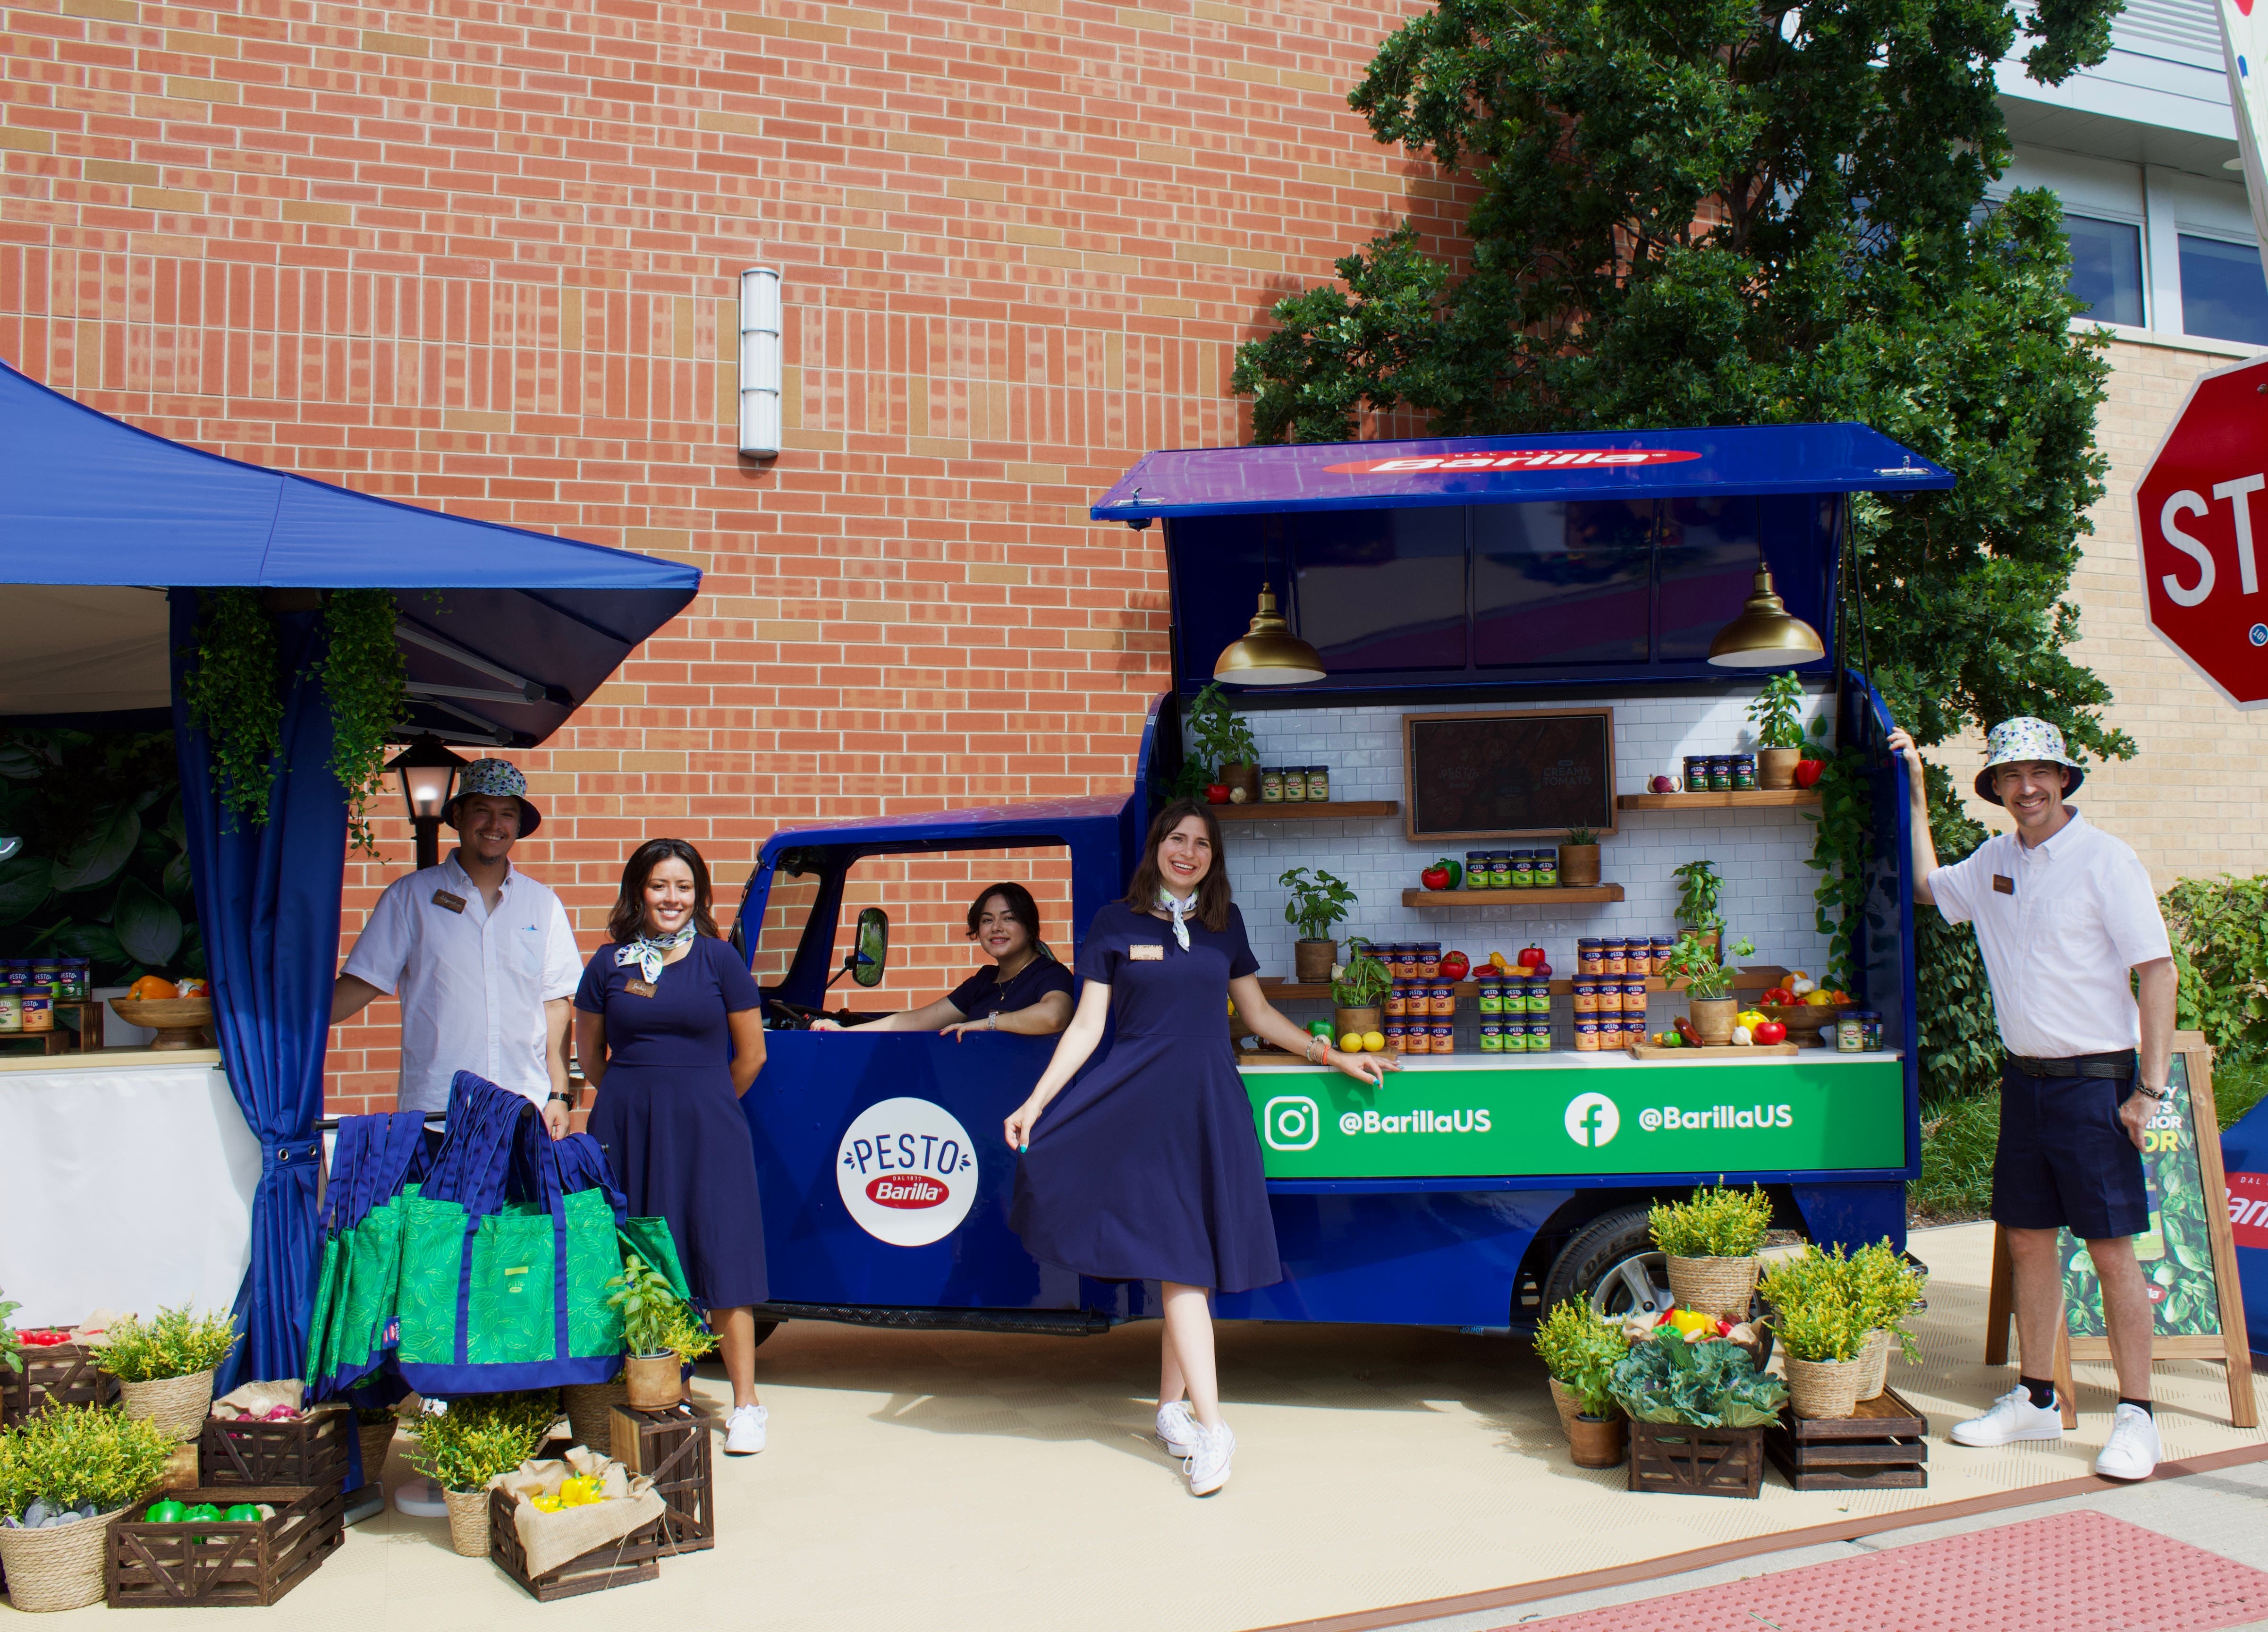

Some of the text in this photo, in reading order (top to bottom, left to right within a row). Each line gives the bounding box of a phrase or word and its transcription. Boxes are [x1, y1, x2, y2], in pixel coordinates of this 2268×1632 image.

[1369, 453, 1649, 471] Barilla
[1339, 1109, 1492, 1135] @BarillaUS
[1639, 1104, 1793, 1131] @BarillaUS
[853, 1133, 959, 1174] PESTO
[876, 1182, 939, 1201] Barilla
[2240, 1176, 2260, 1185] DAL
